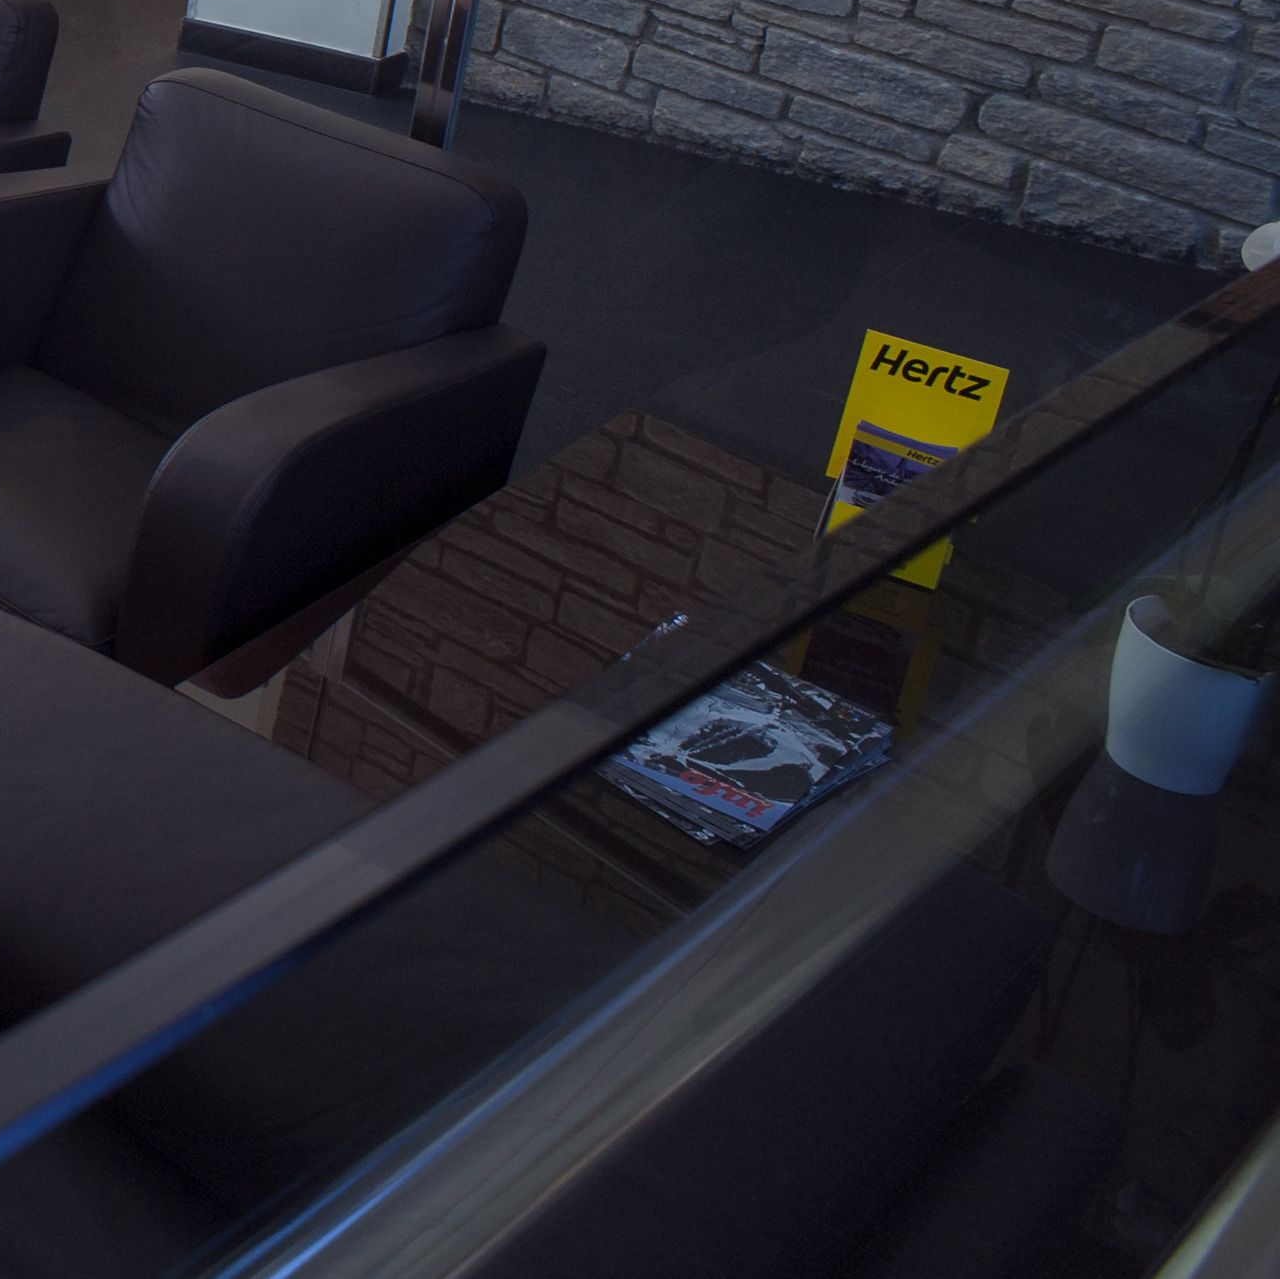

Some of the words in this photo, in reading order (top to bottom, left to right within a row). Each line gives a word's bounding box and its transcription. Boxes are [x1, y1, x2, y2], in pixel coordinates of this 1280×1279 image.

[870, 344, 991, 401] Hertz
[906, 449, 941, 467] Hertz
[679, 769, 775, 819] info
